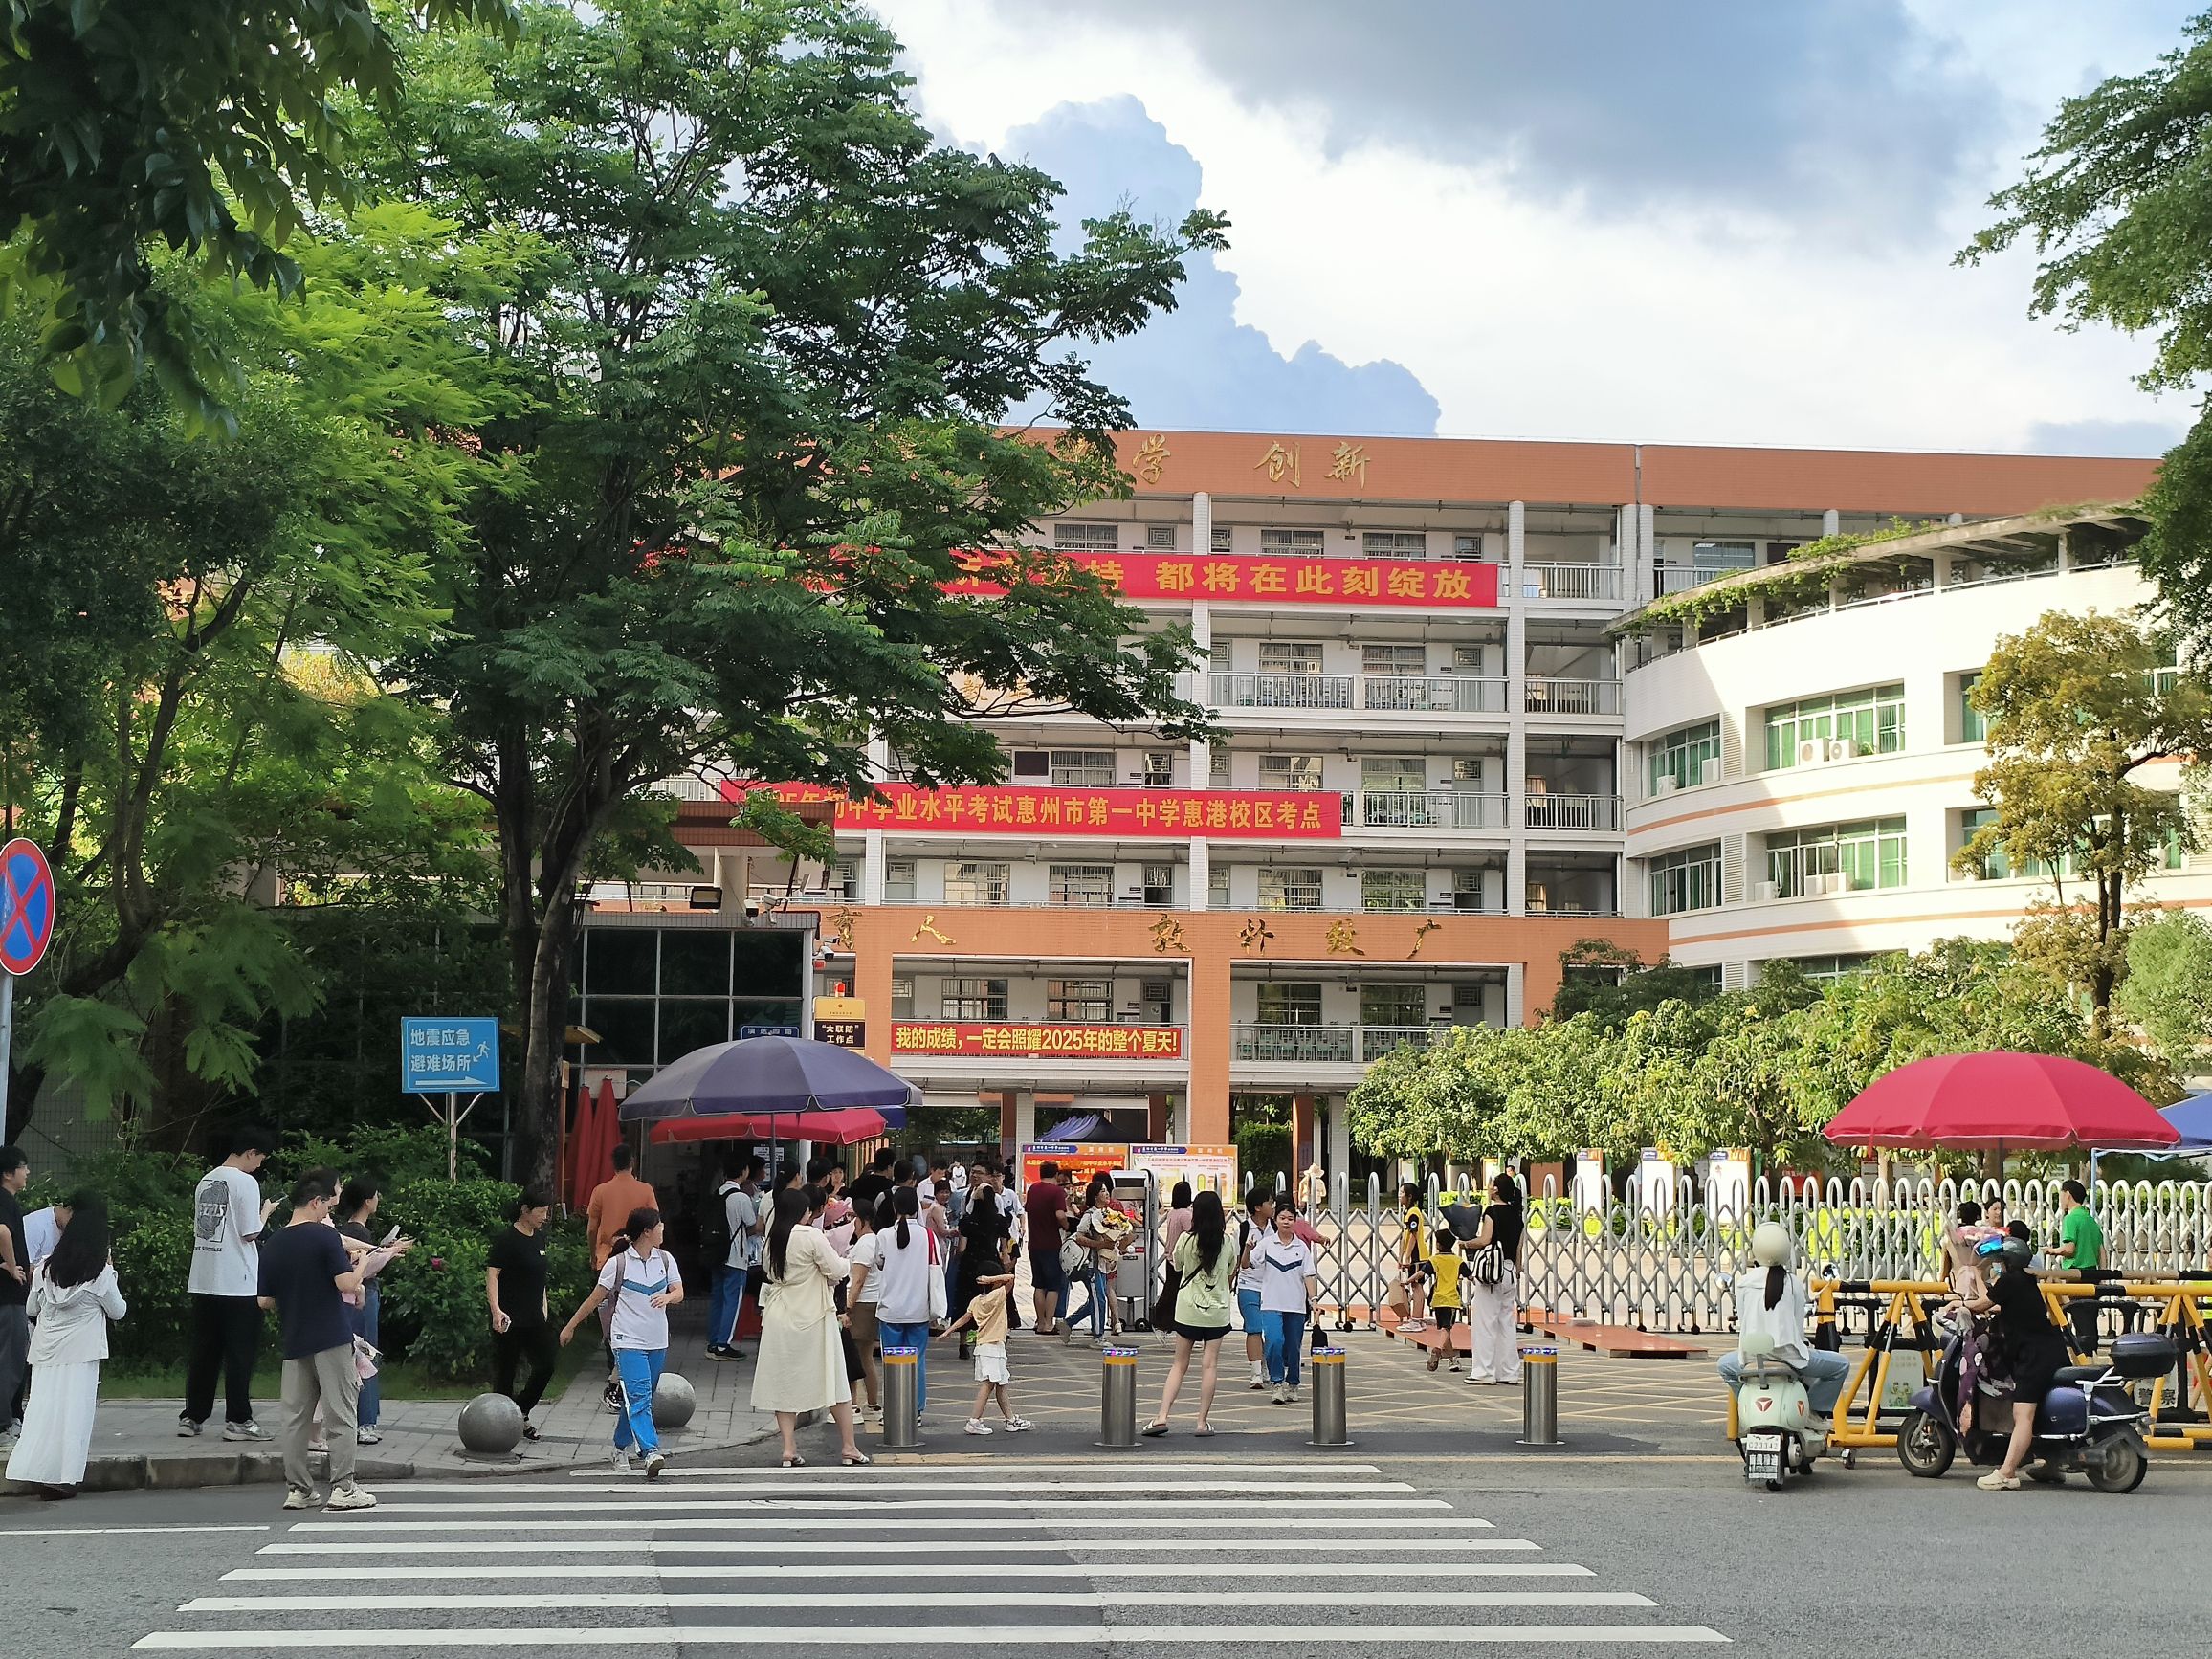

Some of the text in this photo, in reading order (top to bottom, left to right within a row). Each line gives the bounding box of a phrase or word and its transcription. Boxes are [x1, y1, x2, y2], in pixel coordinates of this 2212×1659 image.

[1155, 562, 1472, 600] 都将在此刻绽放
[744, 790, 1322, 830] 初中学业水平考试惠州市第一中学惠港校区考点
[410, 1029, 471, 1047] 地震应急
[826, 1034, 855, 1045] 工作点
[410, 1054, 472, 1073] 避难场所
